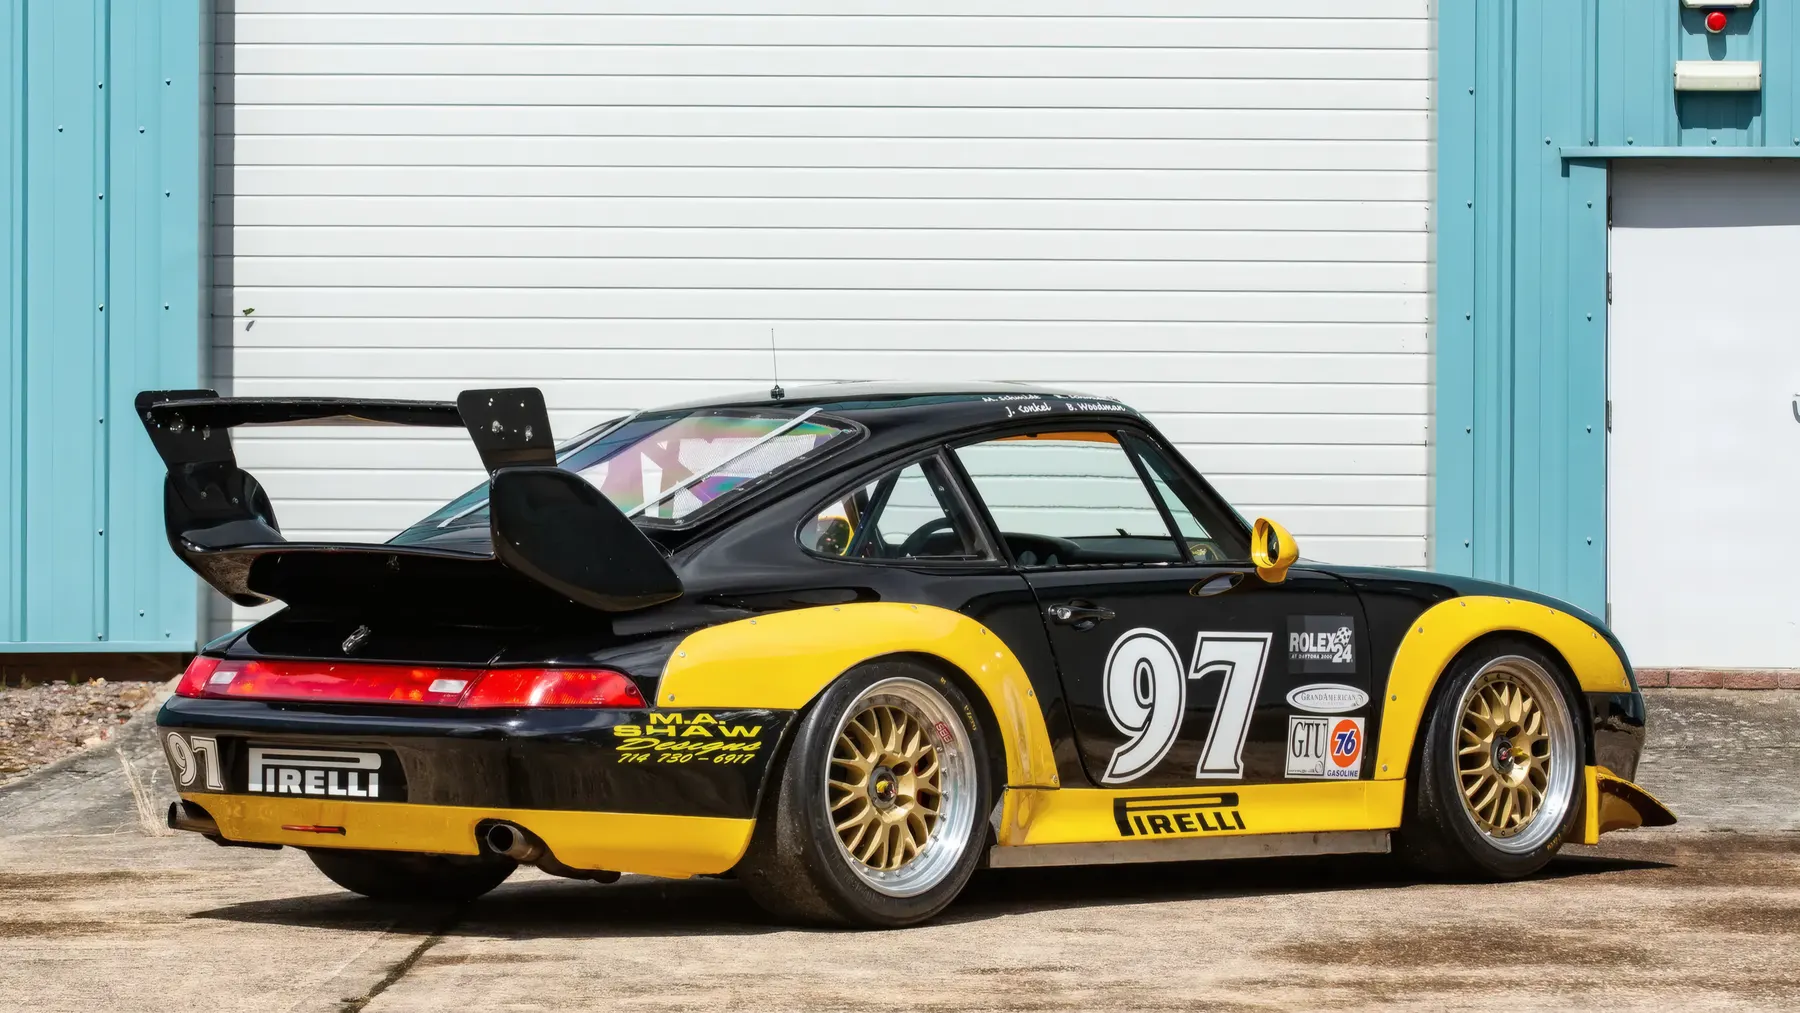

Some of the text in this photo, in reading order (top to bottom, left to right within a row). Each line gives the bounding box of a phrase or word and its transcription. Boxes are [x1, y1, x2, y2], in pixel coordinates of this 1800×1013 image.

[1005, 401, 1126, 418] J. Conkel B. Woodman
[1289, 632, 1353, 663] ROLEX 24
[650, 712, 726, 725] M.A.
[1101, 627, 1273, 784] 97
[613, 725, 762, 737] SHAW
[1291, 721, 1327, 759] GTU
[1332, 729, 1357, 757] 76
[615, 737, 762, 756] Designs
[617, 753, 652, 764] 714
[167, 731, 224, 791] 97
[248, 748, 382, 798] PIRELLI
[1327, 769, 1359, 778] GASOLINE
[1113, 792, 1246, 837] PIRELLI
